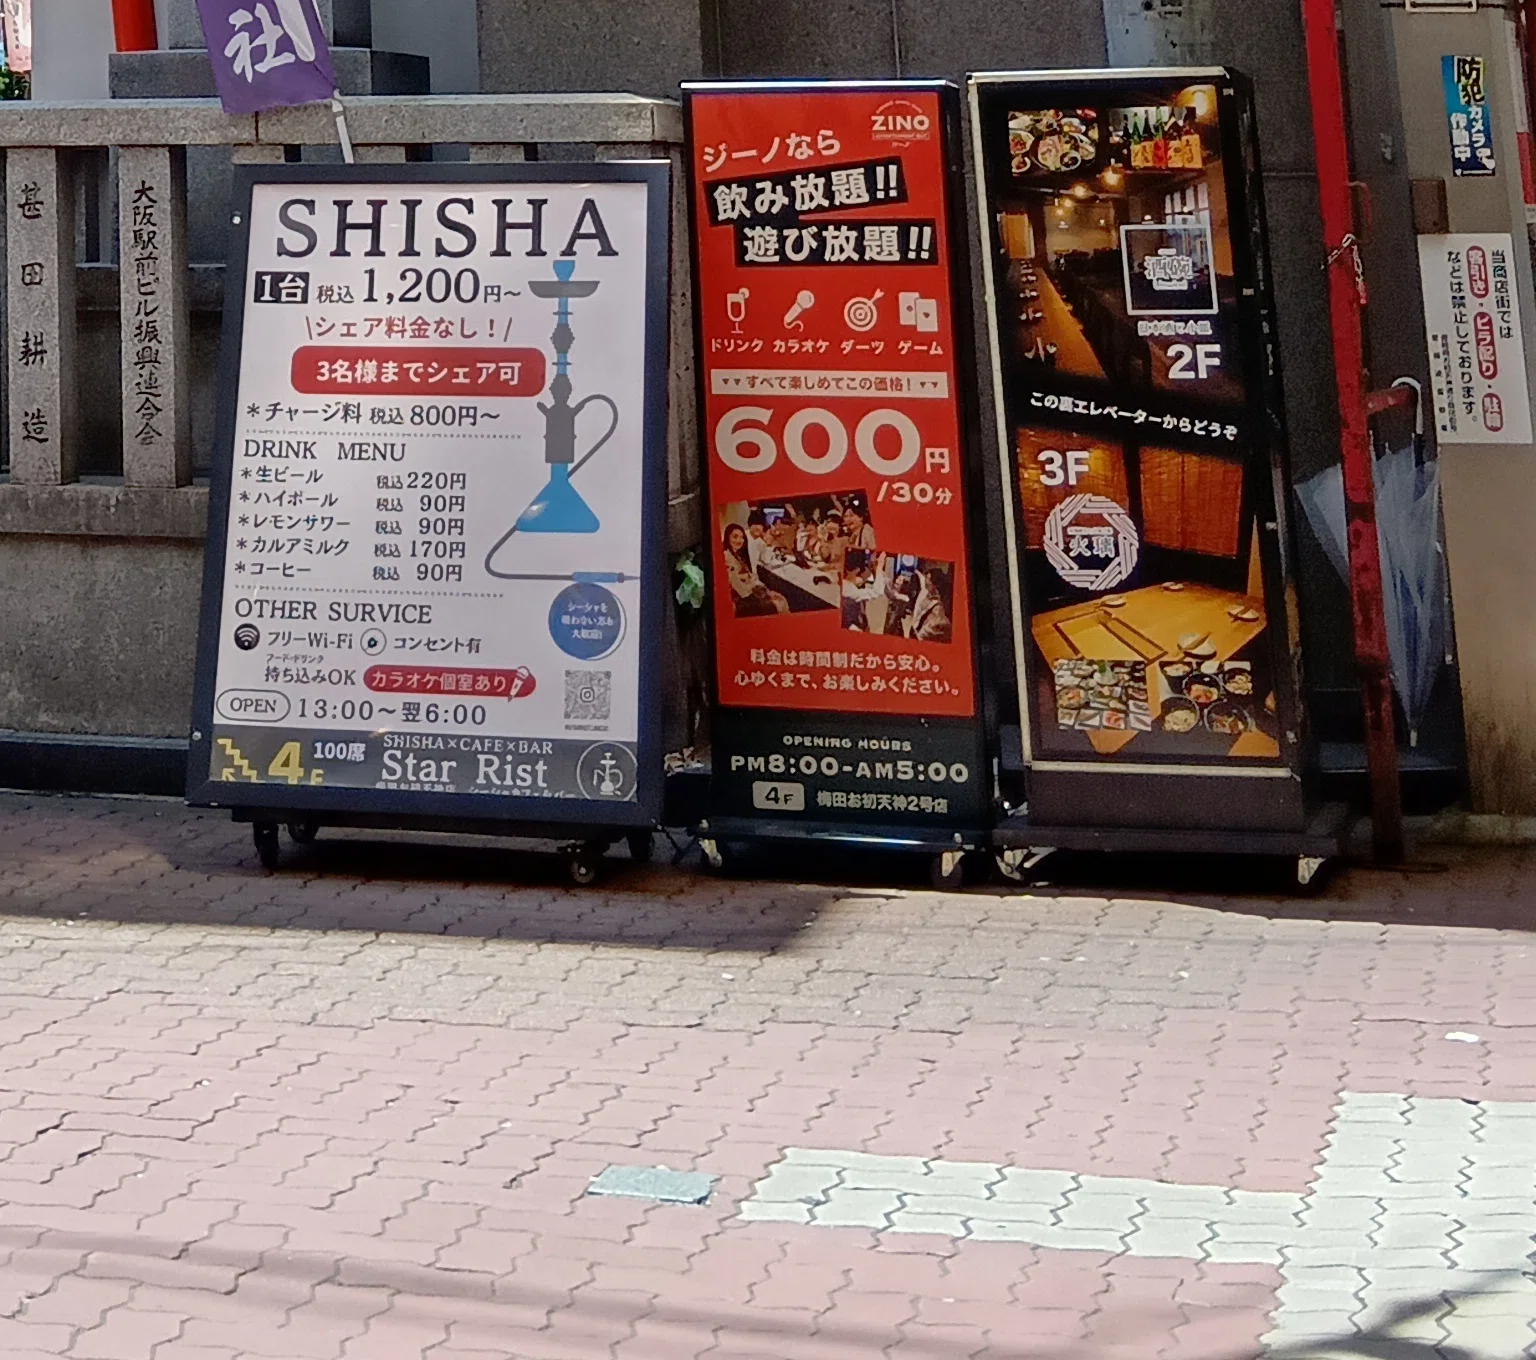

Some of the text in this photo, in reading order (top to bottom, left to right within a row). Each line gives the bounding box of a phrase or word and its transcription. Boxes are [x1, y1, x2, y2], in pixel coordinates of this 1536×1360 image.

[1456, 57, 1484, 105] 防犯
[871, 115, 930, 131] ZINO
[1469, 105, 1485, 147] カメラ
[703, 130, 841, 172] ジーノなら
[276, 198, 619, 257] SHISHA
[258, 276, 308, 304] 1台
[316, 285, 354, 304] 税込
[1492, 250, 1513, 339] 当商店街では
[711, 338, 943, 355] ドリンク カラオケ ダーツ ゲーム
[1447, 250, 1478, 422] などは禁止しております。
[1167, 343, 1221, 379] 2F
[316, 360, 522, 387] 3名様までシェア可
[369, 407, 405, 426] 税込
[243, 439, 406, 462] DRINK MENU
[1037, 450, 1090, 486] 3F
[407, 471, 466, 491] 220円
[420, 494, 466, 513] 90円
[419, 517, 465, 536] 90円
[409, 540, 466, 560] 170円
[416, 563, 463, 583] 90円
[234, 597, 432, 625] OTHER SURVICE
[394, 635, 482, 654] コンセント有
[750, 648, 940, 673] 料金は時間制だから安心。
[264, 668, 357, 687] 持ち込みOK
[371, 671, 507, 693] カラオケ個室あり
[734, 670, 959, 696] 心ゆくまで、お楽しみください。
[229, 698, 277, 713] OPEN
[313, 742, 366, 762] 100席
[783, 735, 912, 752] OPENING HOURS
[381, 750, 548, 787] Star Rist
[730, 754, 969, 783] PM8:00-AM5:00
[765, 786, 794, 806] 4F
[816, 791, 948, 814] 梅田お初天神2号店
